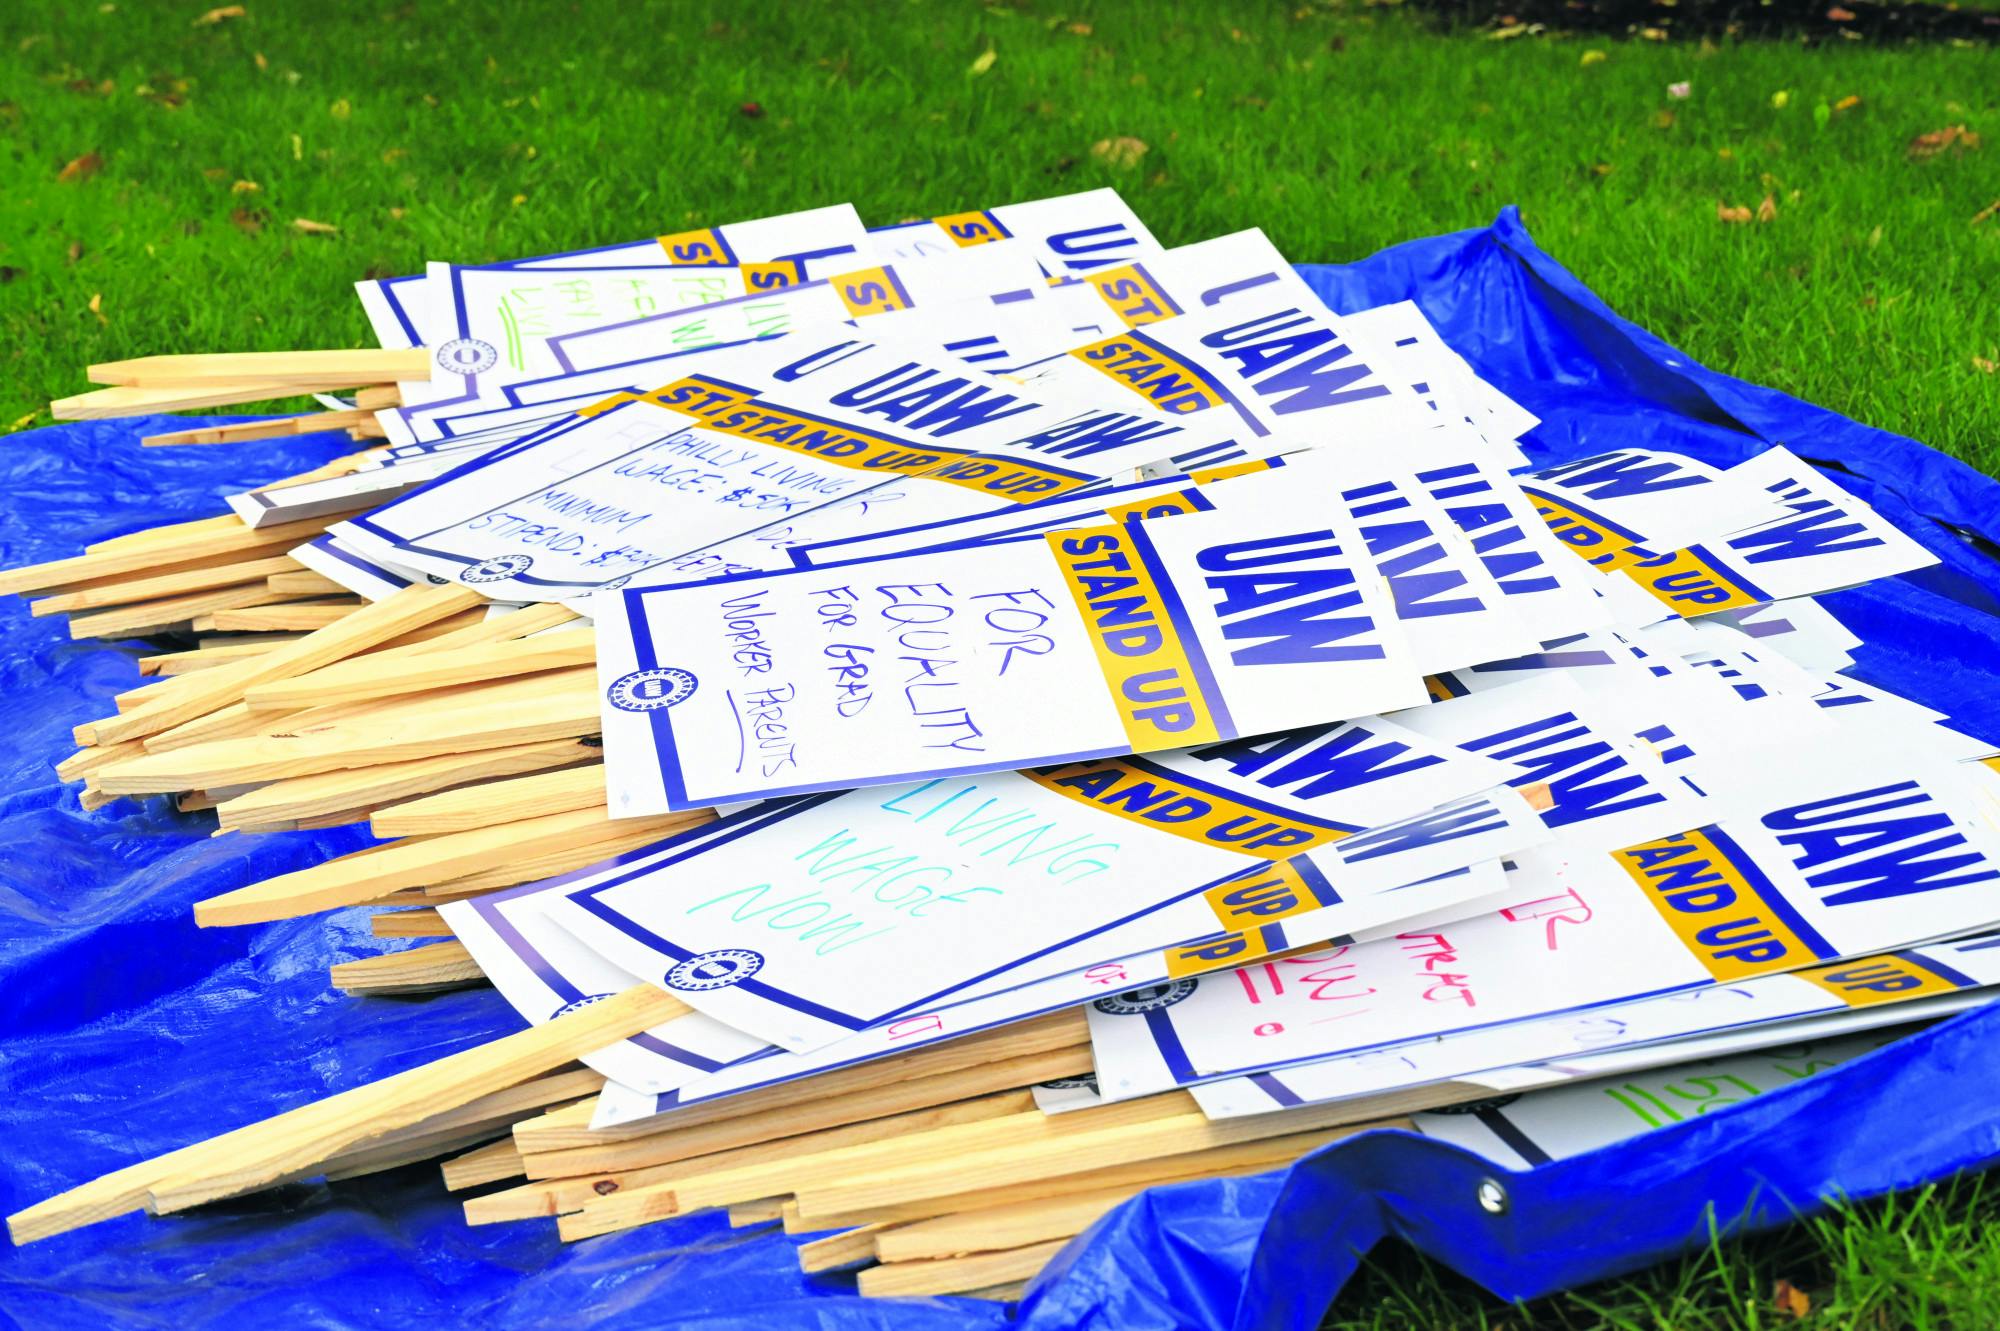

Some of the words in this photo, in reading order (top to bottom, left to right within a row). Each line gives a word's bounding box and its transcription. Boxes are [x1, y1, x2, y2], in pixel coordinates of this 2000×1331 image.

[829, 361, 1043, 437] UAW
[1085, 343, 1211, 415] STAND
[1200, 307, 1392, 416] UAW
[651, 433, 758, 468] PHILLY
[751, 461, 856, 494] LIVING
[711, 410, 869, 458] STAND
[862, 450, 941, 470] UP
[1004, 409, 1186, 459] AW
[526, 490, 653, 534] MINIMUM
[984, 471, 1061, 495] UP
[1530, 452, 1714, 501] AW
[808, 585, 860, 633] FOR
[1195, 528, 1387, 667] UAW
[1652, 570, 1731, 604] UP
[875, 582, 985, 752] EQUALITY
[969, 588, 1056, 677] FOR
[1061, 534, 1164, 658] STAND
[1120, 668, 1196, 733] UP
[823, 643, 875, 718] GRAD
[1186, 719, 1448, 801] AW
[880, 778, 1120, 885] LIVING
[1031, 758, 1213, 824] AND
[1205, 815, 1315, 850] UP
[795, 829, 1003, 917] WAGE
[1760, 780, 2000, 907] UAW
[686, 884, 898, 956] NOW
[1222, 878, 1298, 916] UP
[1624, 834, 1737, 914] AND
[1695, 917, 1788, 964] UP
[1823, 963, 1923, 992] UP
